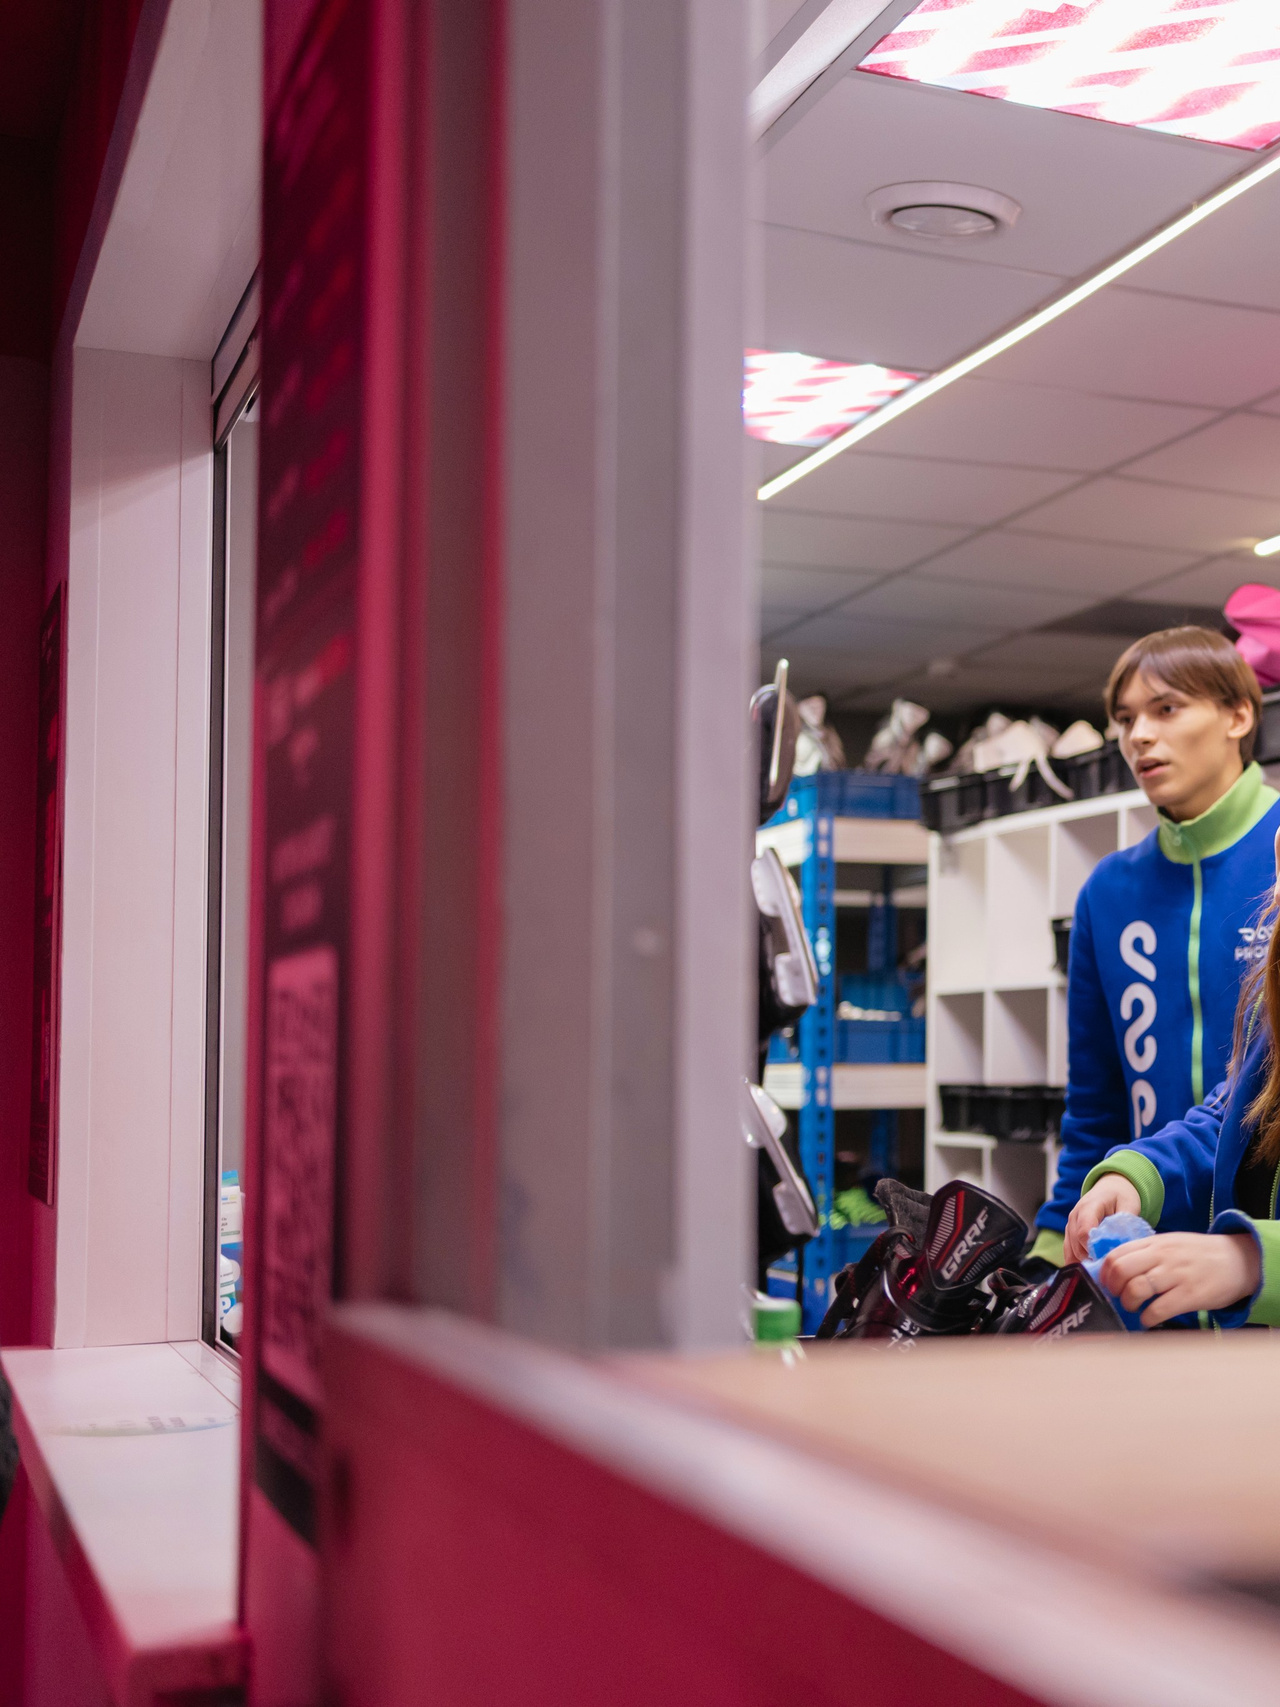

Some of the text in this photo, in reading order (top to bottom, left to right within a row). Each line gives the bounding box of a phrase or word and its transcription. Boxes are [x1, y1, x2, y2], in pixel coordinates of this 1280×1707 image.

[1234, 945, 1271, 961] PRO
[941, 1206, 988, 1280] GRAF
[1034, 1301, 1092, 1343] RAF
